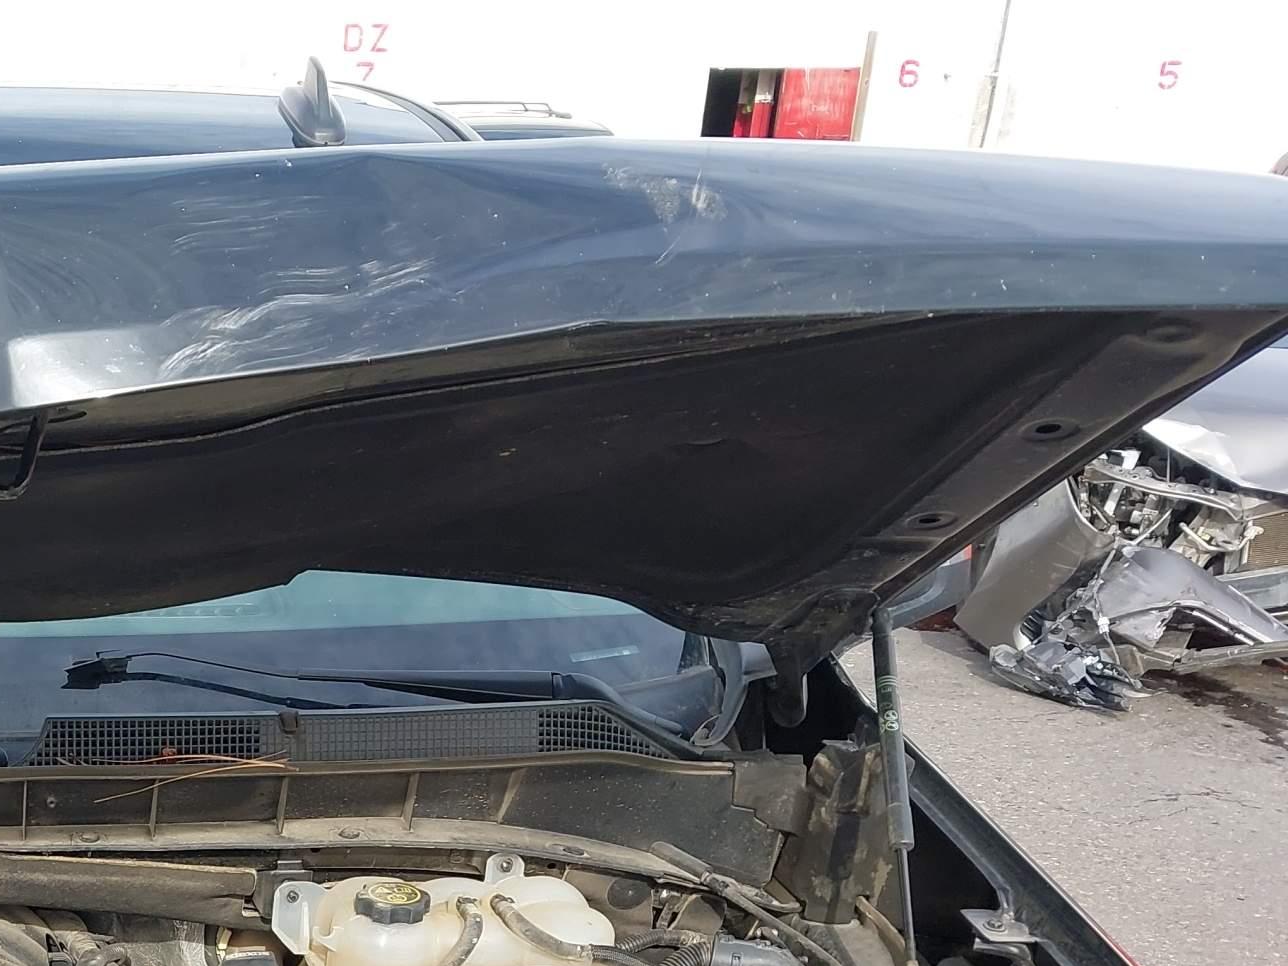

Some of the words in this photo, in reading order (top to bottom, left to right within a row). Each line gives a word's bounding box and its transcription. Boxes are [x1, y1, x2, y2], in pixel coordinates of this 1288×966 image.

[355, 60, 376, 82] 7
[898, 58, 921, 88] 6
[1158, 59, 1183, 90] 5
